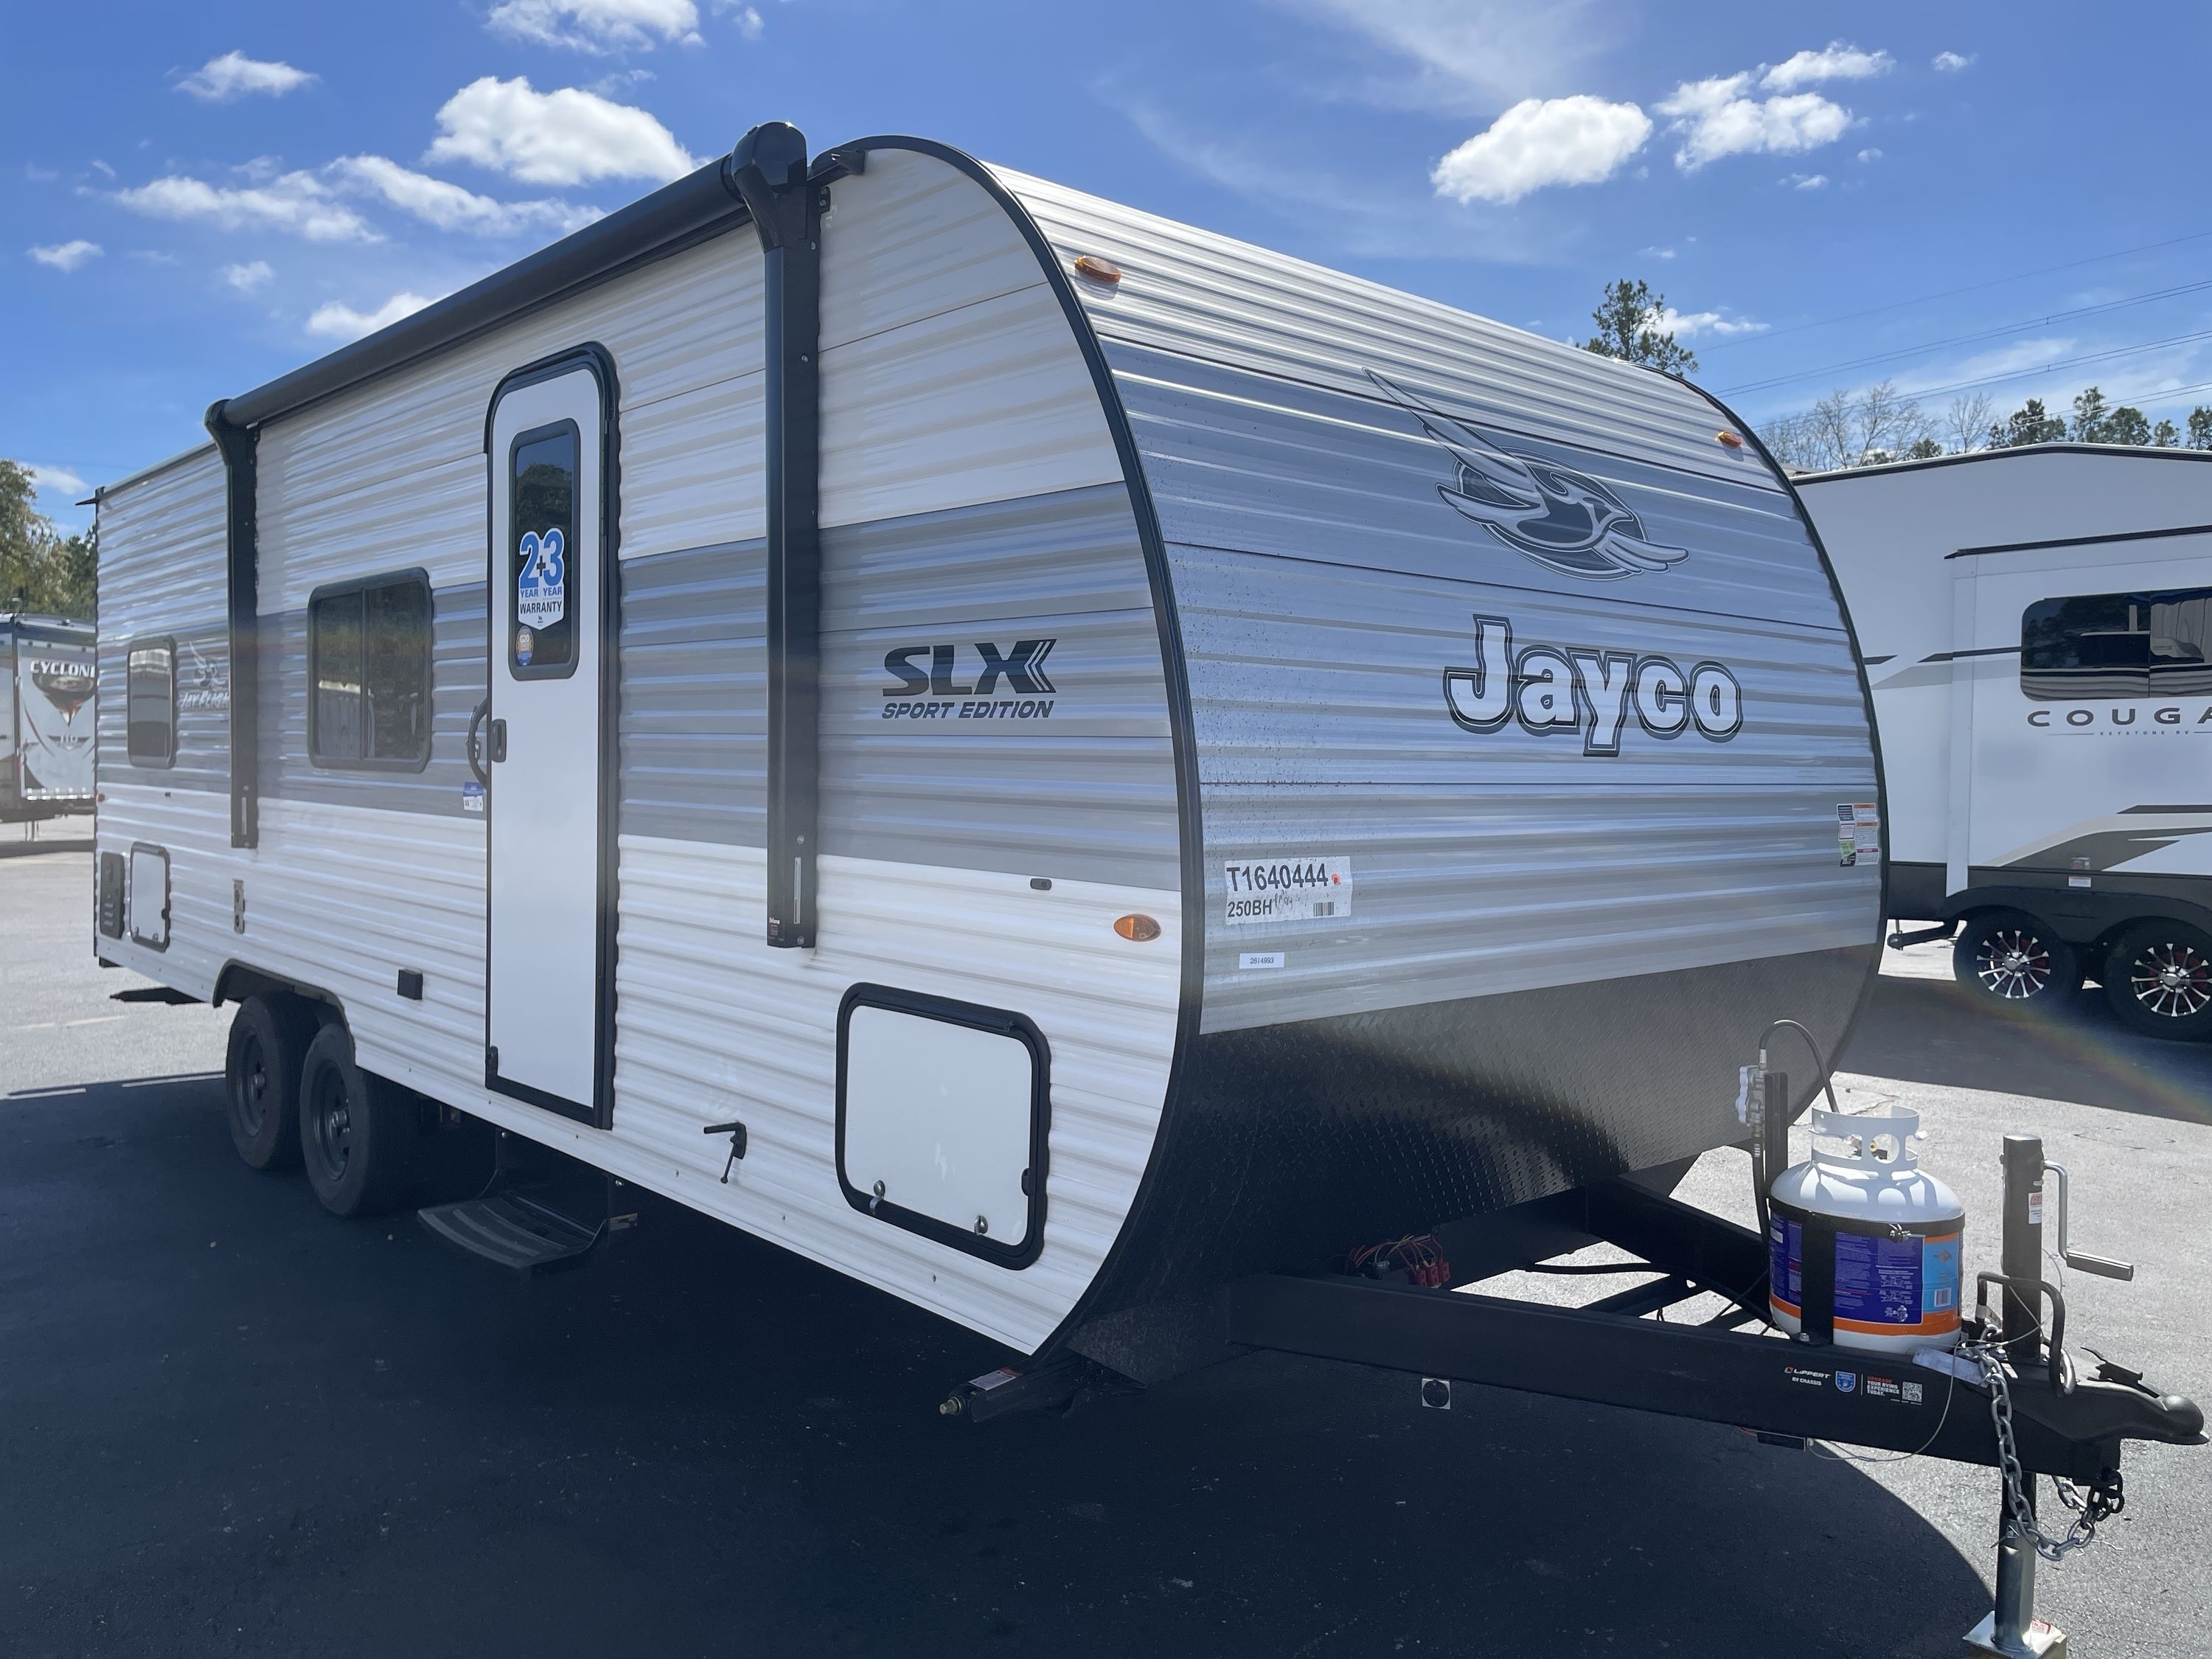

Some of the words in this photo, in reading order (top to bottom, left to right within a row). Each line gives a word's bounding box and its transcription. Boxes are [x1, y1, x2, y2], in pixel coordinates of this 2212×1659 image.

[520, 589, 538, 598] YEAR
[543, 586, 563, 597] YEAR
[520, 601, 562, 614] WARRANTY
[883, 639, 1057, 697] SLX
[1442, 613, 1744, 757] Jayco
[882, 702, 956, 720] SPORT
[959, 700, 1054, 719] EDITION
[1226, 863, 1329, 891] T1640444
[1227, 898, 1273, 918] 250BH
[1800, 1377, 1823, 1386] CHASSIS
[1867, 1385, 1900, 1394] EXPERIENCE
